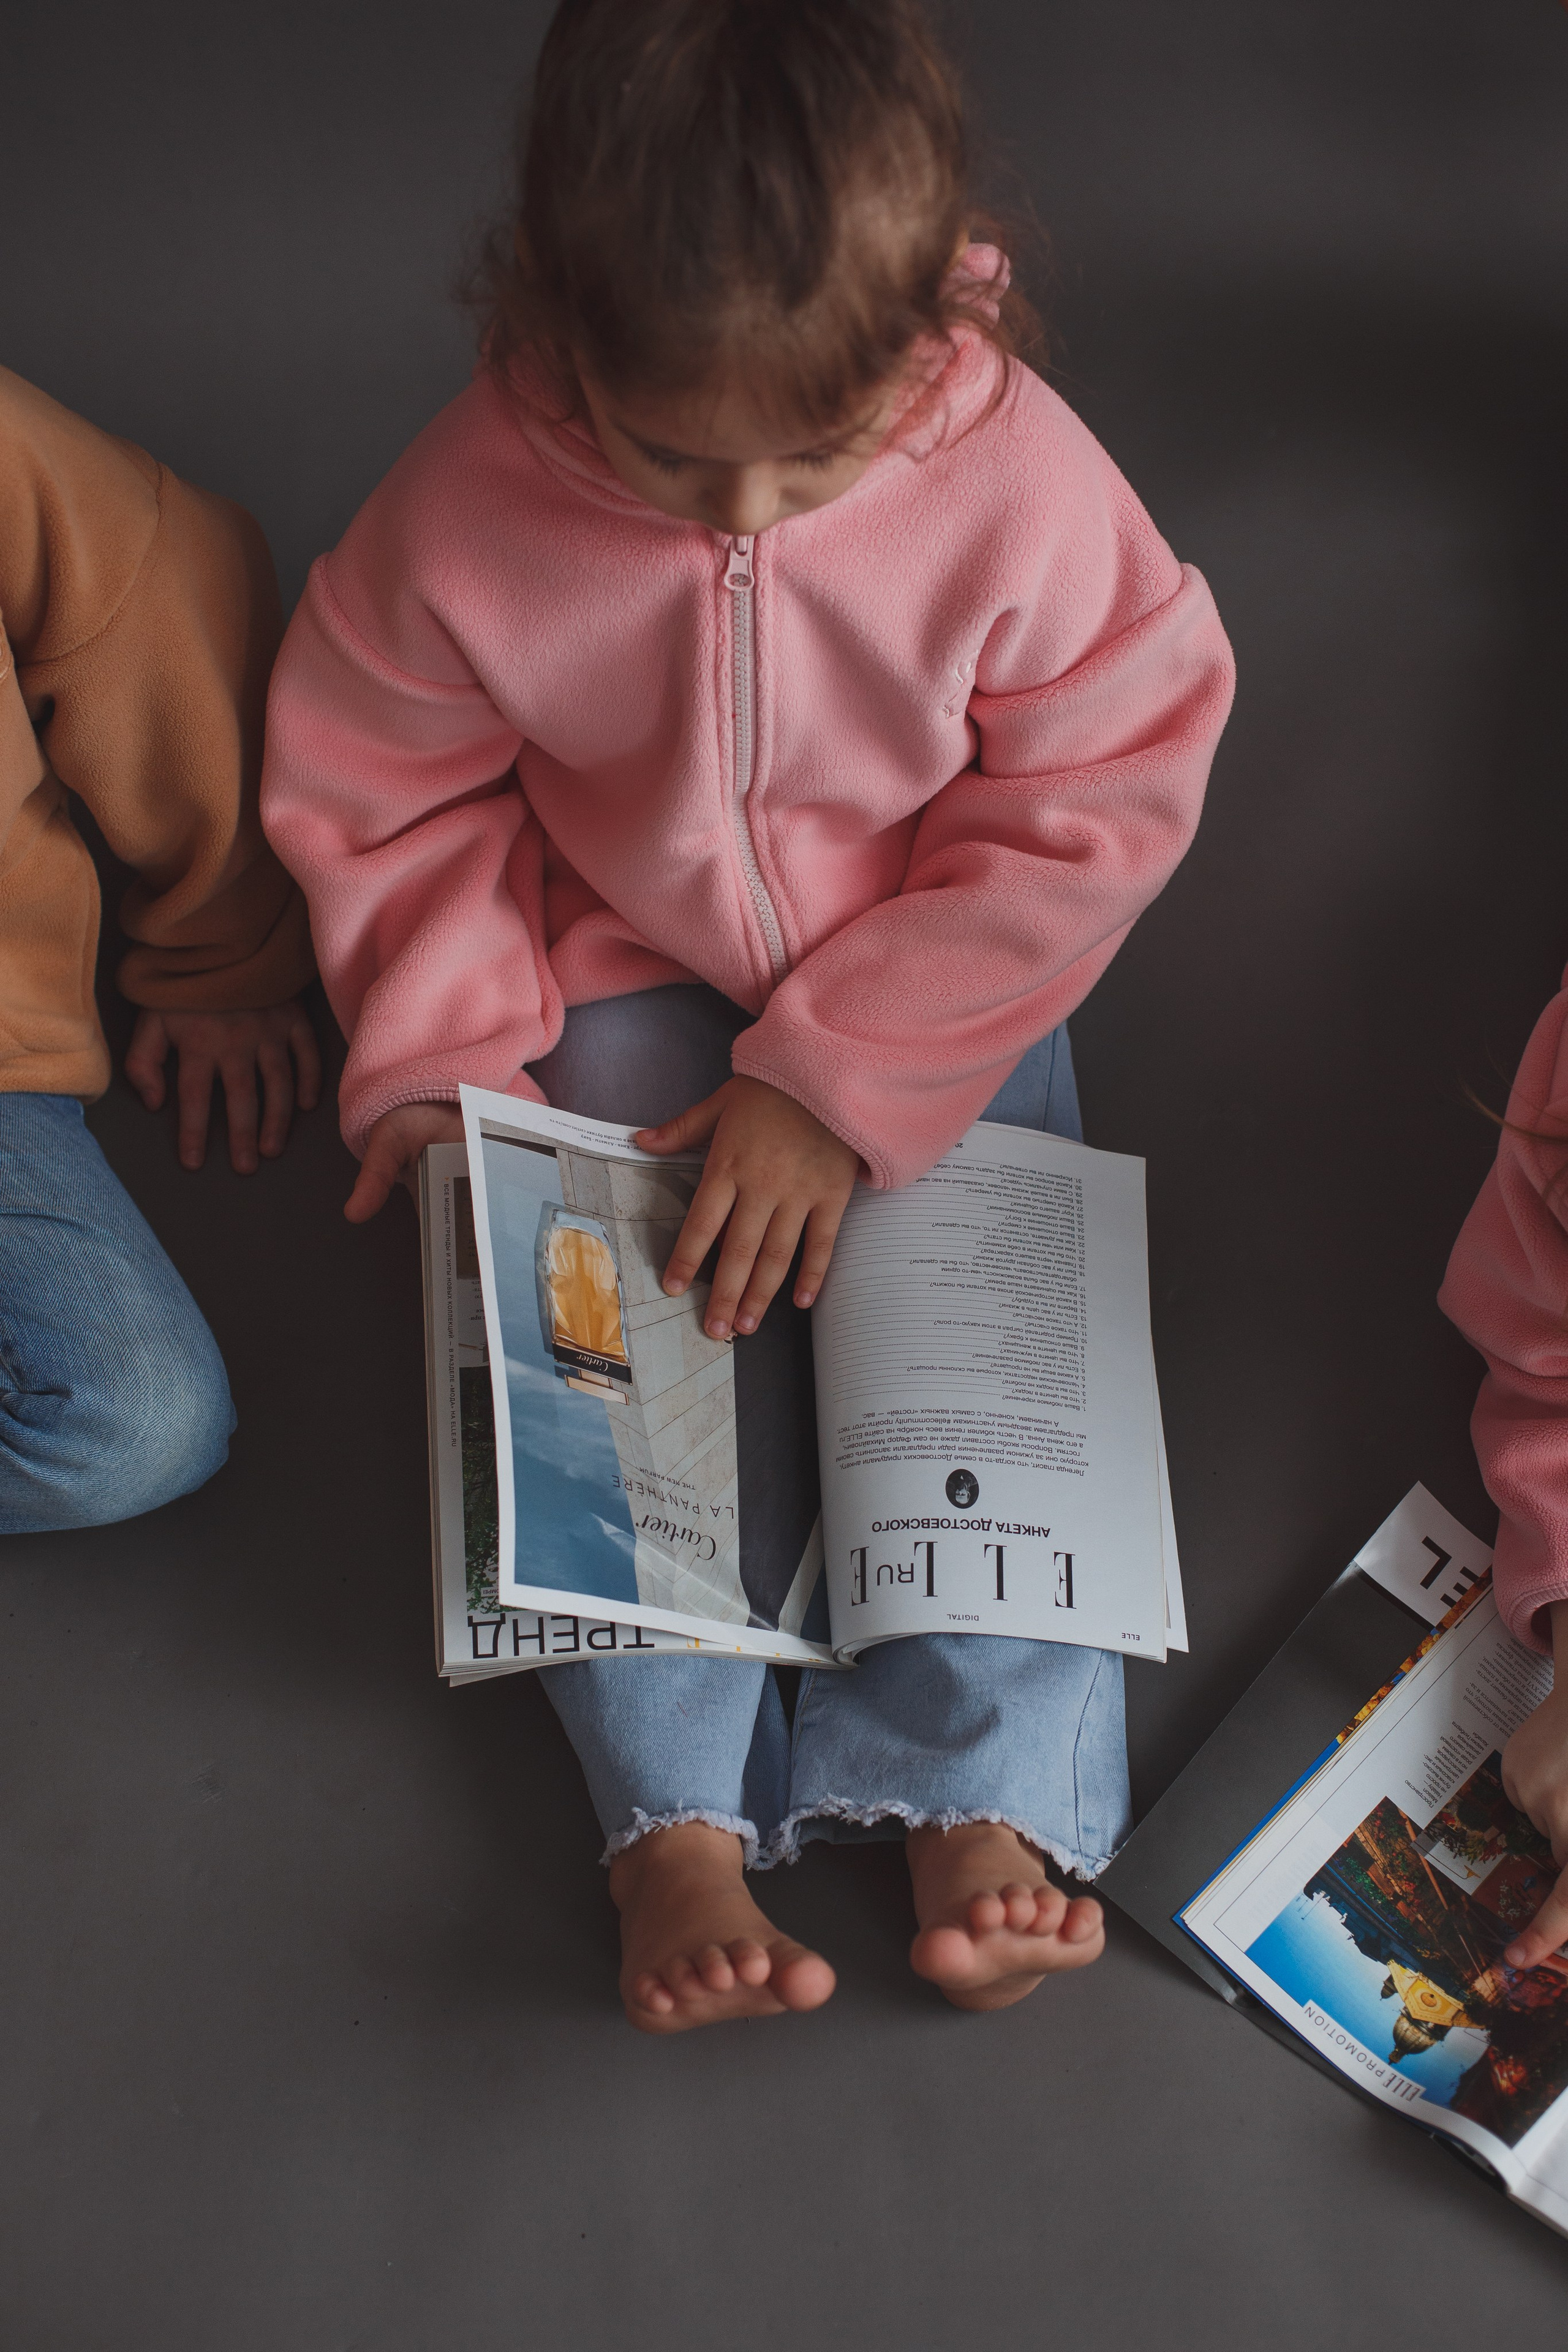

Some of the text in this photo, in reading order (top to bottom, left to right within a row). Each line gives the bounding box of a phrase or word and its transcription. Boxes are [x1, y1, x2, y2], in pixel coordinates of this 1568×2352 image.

[549, 1119, 586, 1134] cartier.com/ru-ru
[986, 1205, 1031, 1216] воспоминания?
[1031, 1212, 1058, 1221] любимые
[980, 1248, 1014, 1257] характера?
[1054, 1259, 1077, 1268] Главная
[1024, 1329, 1055, 1338] родителей
[1055, 1333, 1079, 1343] Пример
[577, 1354, 608, 1372] Cartier
[1003, 1371, 1038, 1381] недостатки,
[1039, 1376, 1080, 1389] Человеческие
[1001, 1394, 1036, 1403] изречение?
[1036, 1399, 1063, 1408] любимое
[983, 1411, 1015, 1420] конечно,
[1016, 1414, 1052, 1425] начинаем,
[867, 1419, 893, 1428] пройти
[953, 1419, 996, 1427] участникам
[997, 1422, 1033, 1431] звездным
[837, 1426, 851, 1434] тест.
[1033, 1427, 1074, 1438] предлагаем
[839, 1432, 863, 1443] ELLE.ru
[1025, 1434, 1046, 1444] Анна.
[842, 1438, 886, 1450] Михайлович,
[1021, 1443, 1053, 1454] Вопросы
[855, 1447, 891, 1457] заполнить
[958, 1446, 1005, 1455] развлечения
[1006, 1450, 1035, 1459] ужином
[1055, 1447, 1080, 1457] гостям.
[835, 1452, 854, 1463] своим
[862, 1454, 902, 1465] придумали
[903, 1453, 952, 1461] Достоевских
[984, 1457, 1016, 1466] когда-то
[1060, 1457, 1089, 1467] которую
[839, 1460, 861, 1471] анкету,
[1030, 1461, 1055, 1471] гласит,
[639, 1467, 664, 1480] PARFUM
[1056, 1465, 1085, 1477] Легенда
[666, 1477, 680, 1486] NEW
[611, 1475, 734, 1519] LA PANTHÈRE
[872, 1518, 1051, 1538] АНКЕТА ДОСТОЕВСКОГО
[636, 1515, 716, 1561] Cartier
[876, 1563, 914, 1586] RU
[467, 1613, 655, 1659] ТРЕНД
[1304, 2007, 1420, 2101] ELLE PROMOTION
